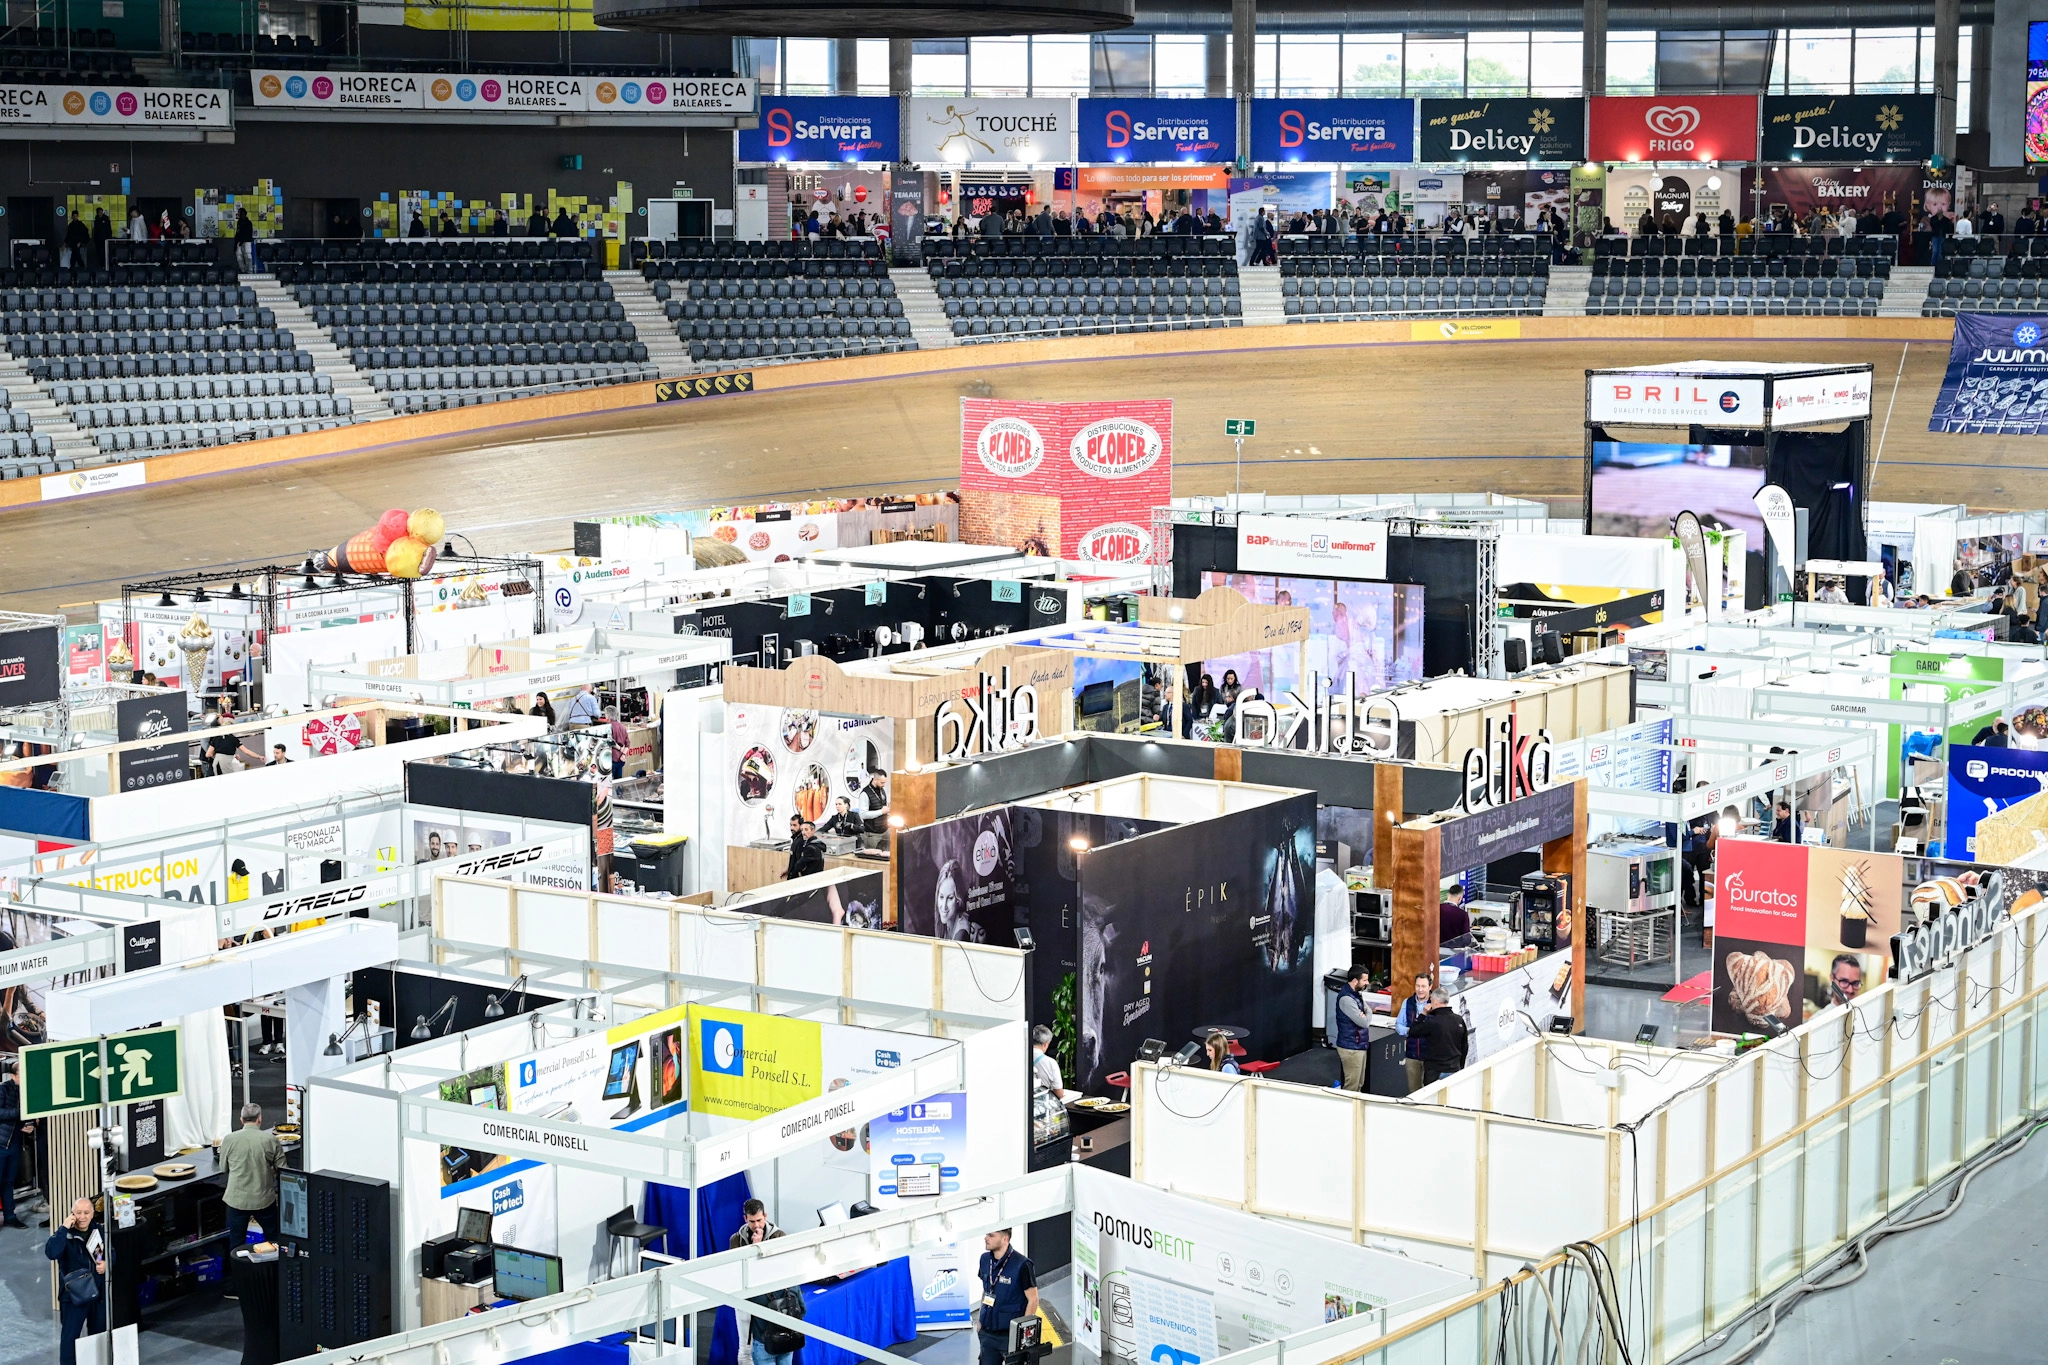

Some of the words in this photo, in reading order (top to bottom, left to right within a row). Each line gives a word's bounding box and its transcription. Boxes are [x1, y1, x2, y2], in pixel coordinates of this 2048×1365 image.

[340, 77, 417, 93] HORECA
[508, 80, 581, 96] HORECA
[673, 82, 746, 97] HORECA
[144, 92, 221, 109] HORECA
[340, 94, 391, 104] BALEARES
[508, 97, 556, 106] BALEARES
[673, 98, 722, 108] BALEARES
[145, 110, 195, 120] BALEARES
[1429, 115, 1448, 127] me
[1450, 102, 1490, 125] gusta!
[1772, 111, 1792, 124] me
[1794, 99, 1836, 123] gusta!
[819, 116, 871, 125] Distribuciones
[976, 113, 1057, 132] TOUCHÉ
[1157, 118, 1209, 126] Distribuciones
[1332, 118, 1386, 126] Distribuciones
[795, 121, 872, 139] Servera
[1133, 122, 1209, 141] Servera
[1307, 122, 1386, 141] Servera
[1887, 132, 1906, 140] food
[838, 142, 856, 151] Food
[856, 140, 883, 150] facility
[1004, 135, 1030, 147] CAFÉ
[1450, 129, 1536, 155] Delicy
[1539, 142, 1572, 150] solutions
[1540, 135, 1557, 143] food
[1650, 139, 1695, 152] FRIGO
[1793, 126, 1883, 153] Delicy
[1887, 139, 1922, 147] solutions
[1175, 143, 1195, 152] Food
[1196, 141, 1220, 151] facility
[1351, 143, 1369, 152] Food
[1370, 141, 1397, 151] facility
[1125, 173, 1140, 183] todo
[1142, 175, 1157, 185] para
[1158, 175, 1170, 183] ser
[1171, 173, 1181, 182] los
[1182, 173, 1217, 184] primeros"
[1575, 176, 1601, 184] MAGNUM
[1812, 176, 1840, 188] Delicy
[1923, 179, 1954, 191] Delicy
[673, 189, 692, 198] SALIDA
[1353, 182, 1381, 192] Florette
[1818, 186, 1871, 198] BAKERY
[1655, 191, 1690, 200] MAGNUM
[1613, 385, 1708, 403] BRIL
[1834, 391, 1849, 399] KIMBO
[1613, 407, 1645, 415] QUALITY
[1671, 408, 1709, 416] SERVICES
[990, 422, 1031, 437] DISTRIBUCIONES
[1087, 423, 1145, 438] DISTRIBUCIONES
[989, 431, 1032, 464] PLOMER
[1087, 431, 1148, 465] PLOMER
[980, 441, 1007, 471] PRODUCTOS
[1006, 446, 1041, 473] ALIMENTACION
[1074, 446, 1113, 474] PRODUCTOS
[1113, 443, 1158, 474] ALIMENTACION
[1091, 526, 1139, 540] DISTRIBUCIONES
[1091, 534, 1141, 561] PLOMER
[584, 566, 630, 580] AudensFood
[295, 612, 302, 620] DE
[308, 609, 325, 618] COCINA
[335, 606, 350, 615] HUERTA
[1532, 608, 1548, 617] AÚN
[702, 614, 727, 628] HOTEL
[702, 627, 733, 638] EDITION
[1264, 624, 1276, 639] Des
[1277, 623, 1286, 636] de
[1286, 619, 1304, 634] 1954
[658, 655, 674, 664] TEMPLO
[675, 653, 688, 663] CAFES
[489, 664, 510, 674] Templo
[528, 675, 546, 686] TEMPLO
[546, 674, 561, 683] CAFES
[1030, 668, 1051, 686] Cada
[365, 682, 385, 692] TEMPLO
[386, 684, 402, 693] CAFES
[2032, 681, 2045, 691] GARCIMAR
[1830, 704, 1867, 714] GARCIMAR
[1973, 700, 1987, 711] GARCIMAR
[1726, 785, 1735, 796] SHAT
[1735, 782, 1747, 795] BALEAR
[288, 825, 341, 844] PERSONALIZA
[295, 840, 305, 849] TU
[306, 835, 335, 848] MARCA
[529, 874, 582, 891] IMPRESIÓN
[263, 885, 367, 920] DYRECO
[1186, 882, 1228, 912] ÉPIK
[1730, 885, 1798, 910] puratos
[1730, 905, 1744, 913] Food
[1744, 907, 1772, 916] Innovation
[1772, 909, 1781, 917] for
[1781, 910, 1798, 919] Good
[223, 917, 231, 926] L5
[129, 936, 157, 949] Culligan
[20, 956, 48, 971] WATER
[1123, 1001, 1135, 1012] DRY
[1135, 997, 1150, 1009] AGED
[725, 1043, 777, 1064] Comercial
[876, 1051, 891, 1059] Cash
[527, 1058, 561, 1080] Comercial
[561, 1050, 585, 1069] Ponsell
[585, 1048, 597, 1060] S.L.
[751, 1065, 790, 1085] Ponsell
[791, 1071, 811, 1088] S.L.
[720, 1150, 731, 1162] A71
[781, 1112, 823, 1139] COMERCIAL
[824, 1100, 856, 1126] PONSELL
[896, 1124, 941, 1135] HOSTELERÍA
[483, 1122, 541, 1144] COMERCIAL
[543, 1133, 589, 1152] PONSELL
[494, 1185, 511, 1200] Cash
[494, 1194, 523, 1214] Protect
[1324, 1281, 1354, 1296] SECTORES
[1354, 1290, 1363, 1298] DE
[1363, 1292, 1388, 1305] INTERÉS
[1149, 1315, 1198, 1336] BIENVENIDOS
